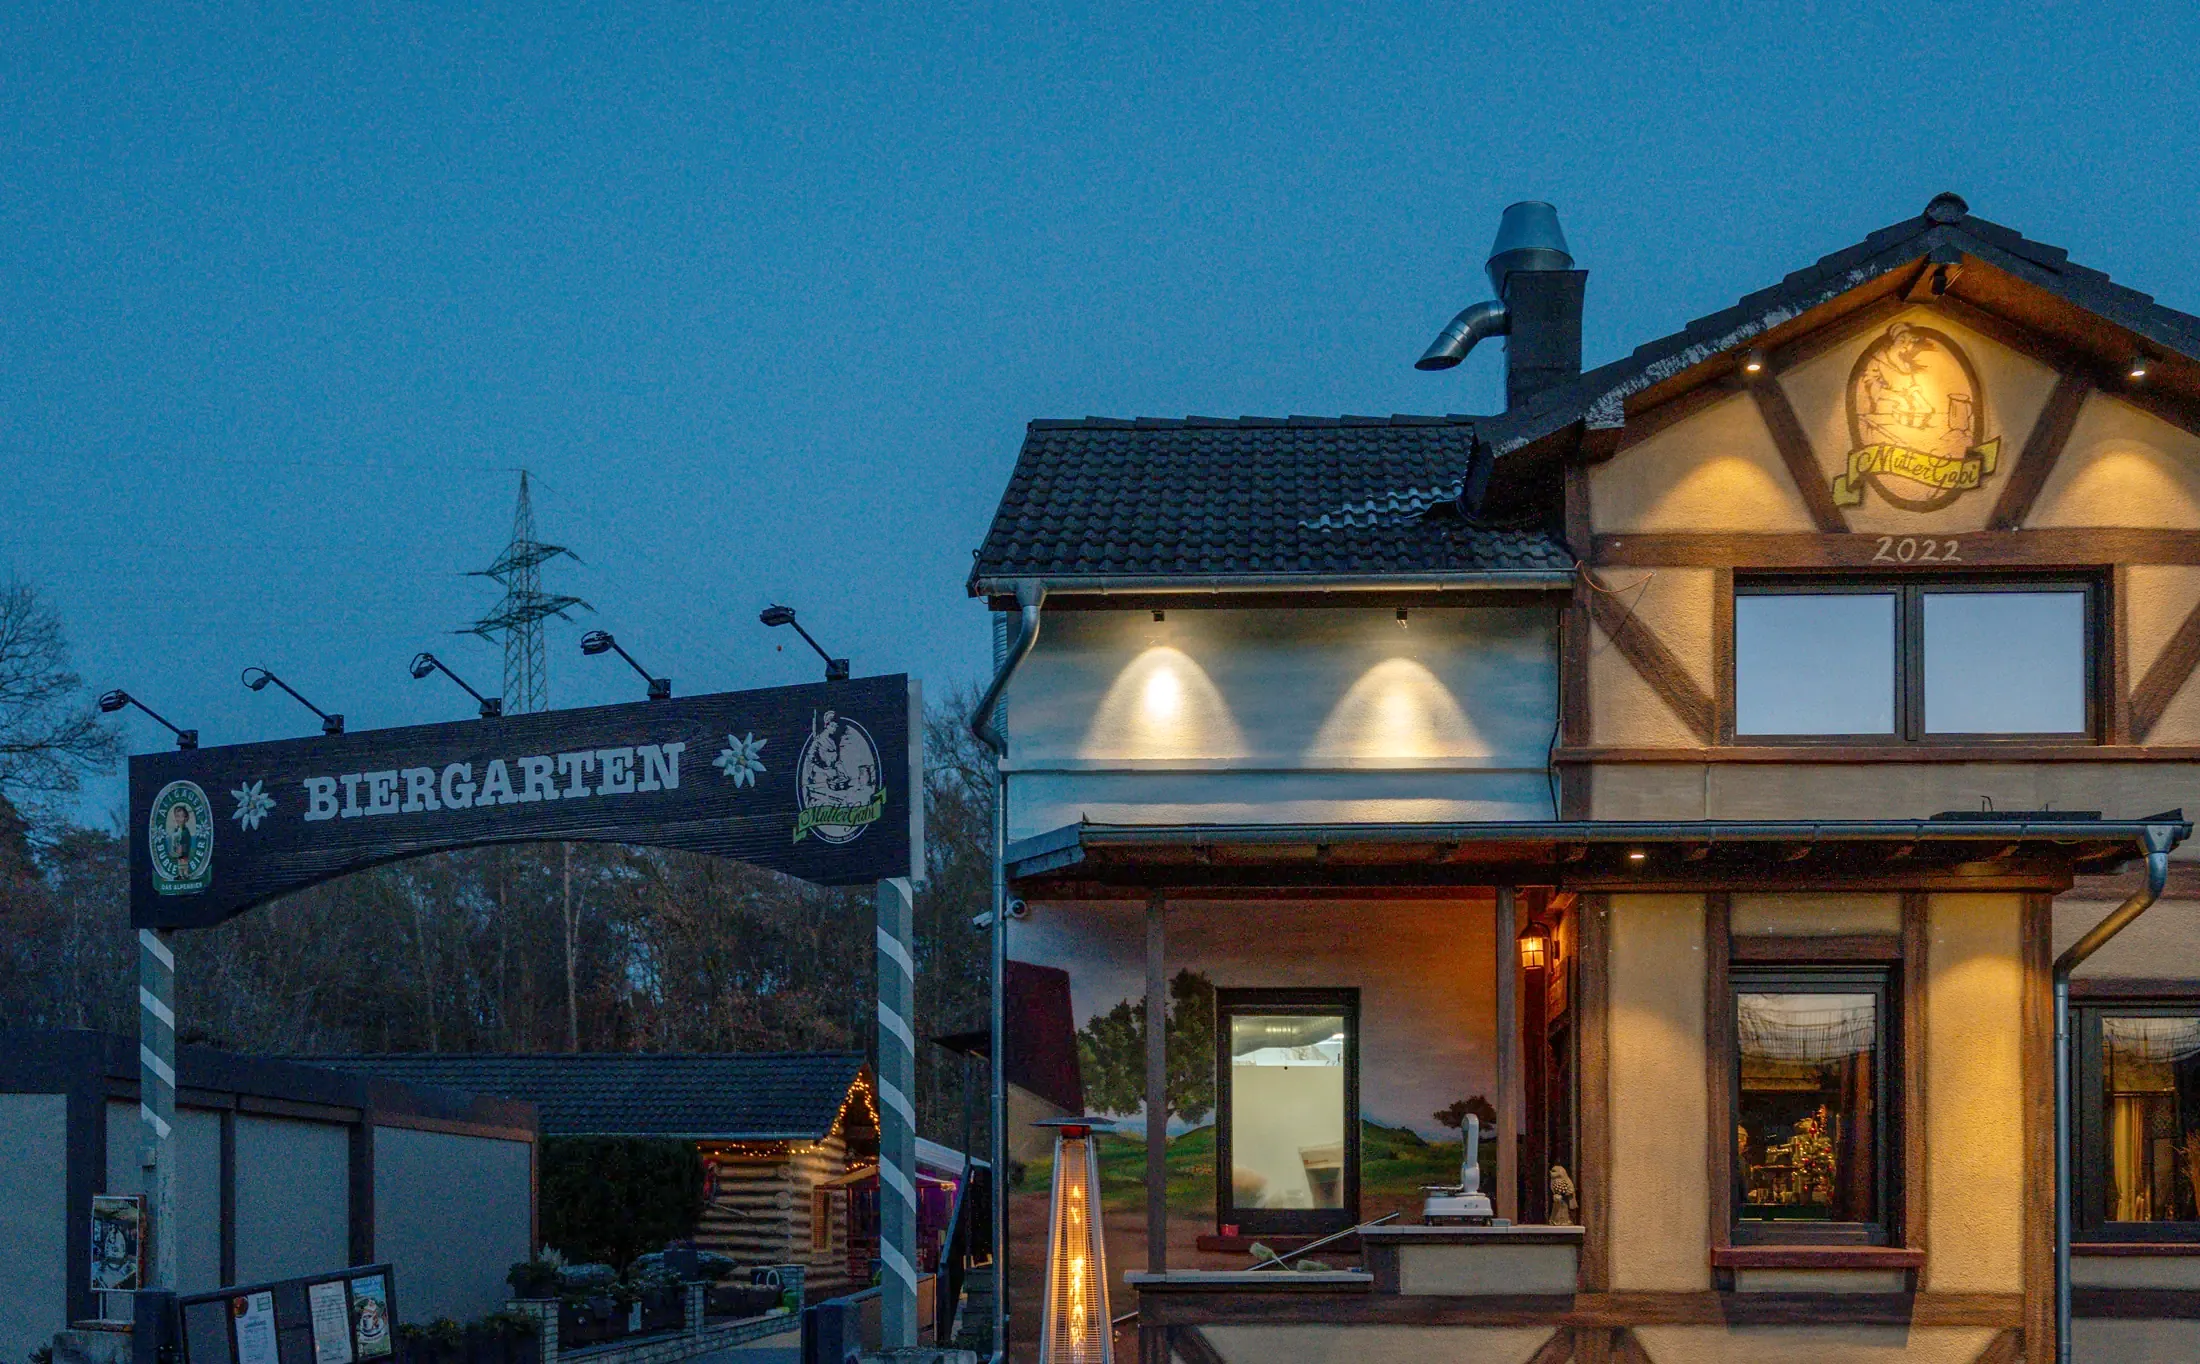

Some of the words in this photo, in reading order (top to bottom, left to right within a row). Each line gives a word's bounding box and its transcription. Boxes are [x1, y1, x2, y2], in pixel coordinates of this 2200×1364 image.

[1872, 536, 1962, 563] 2022
[303, 742, 686, 821] BIERGARTEN
[189, 842, 206, 870] BIER
